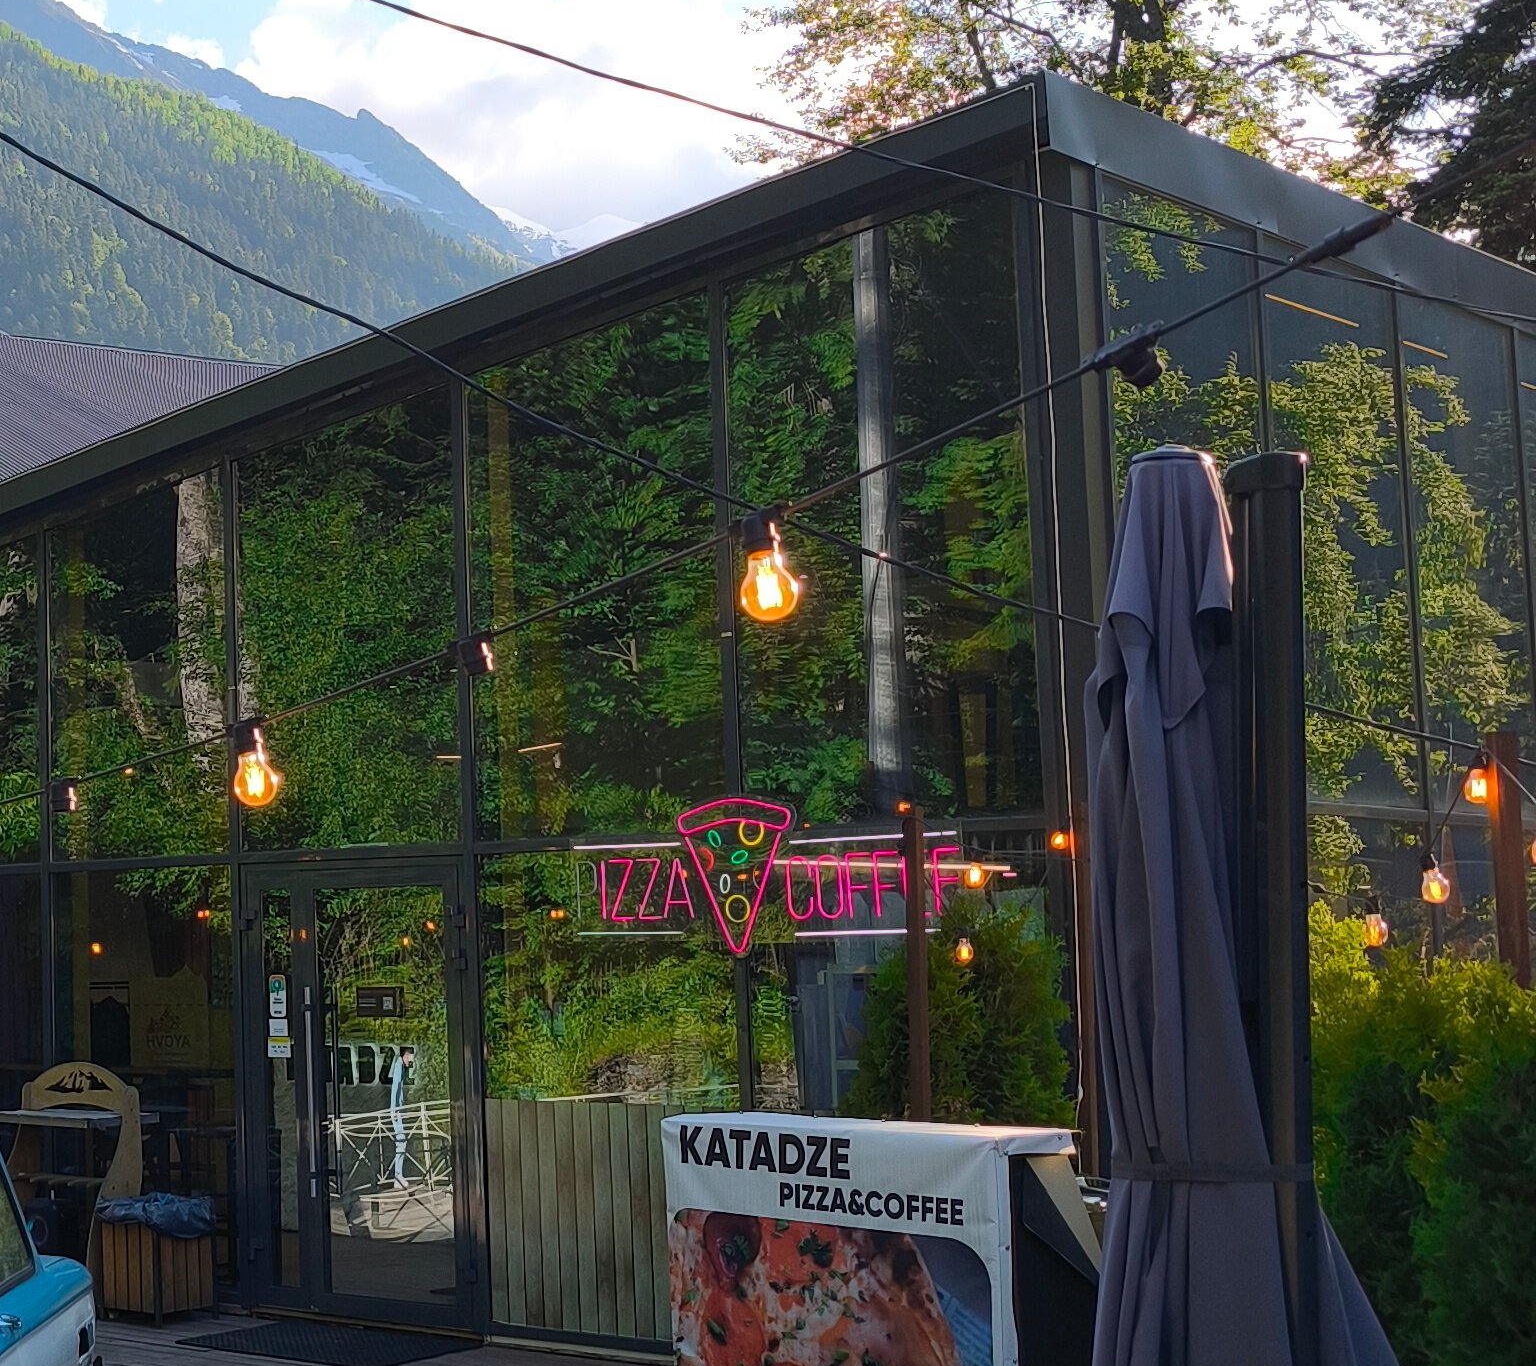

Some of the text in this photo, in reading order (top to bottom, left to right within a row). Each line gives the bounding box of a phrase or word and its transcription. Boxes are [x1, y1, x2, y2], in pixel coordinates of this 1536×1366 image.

[576, 846, 960, 922] PIZZA COFFE
[146, 1035, 191, 1048] HVOYA
[680, 1124, 851, 1180] KATADZE
[779, 1182, 964, 1226] PIZZA&COFFEE
